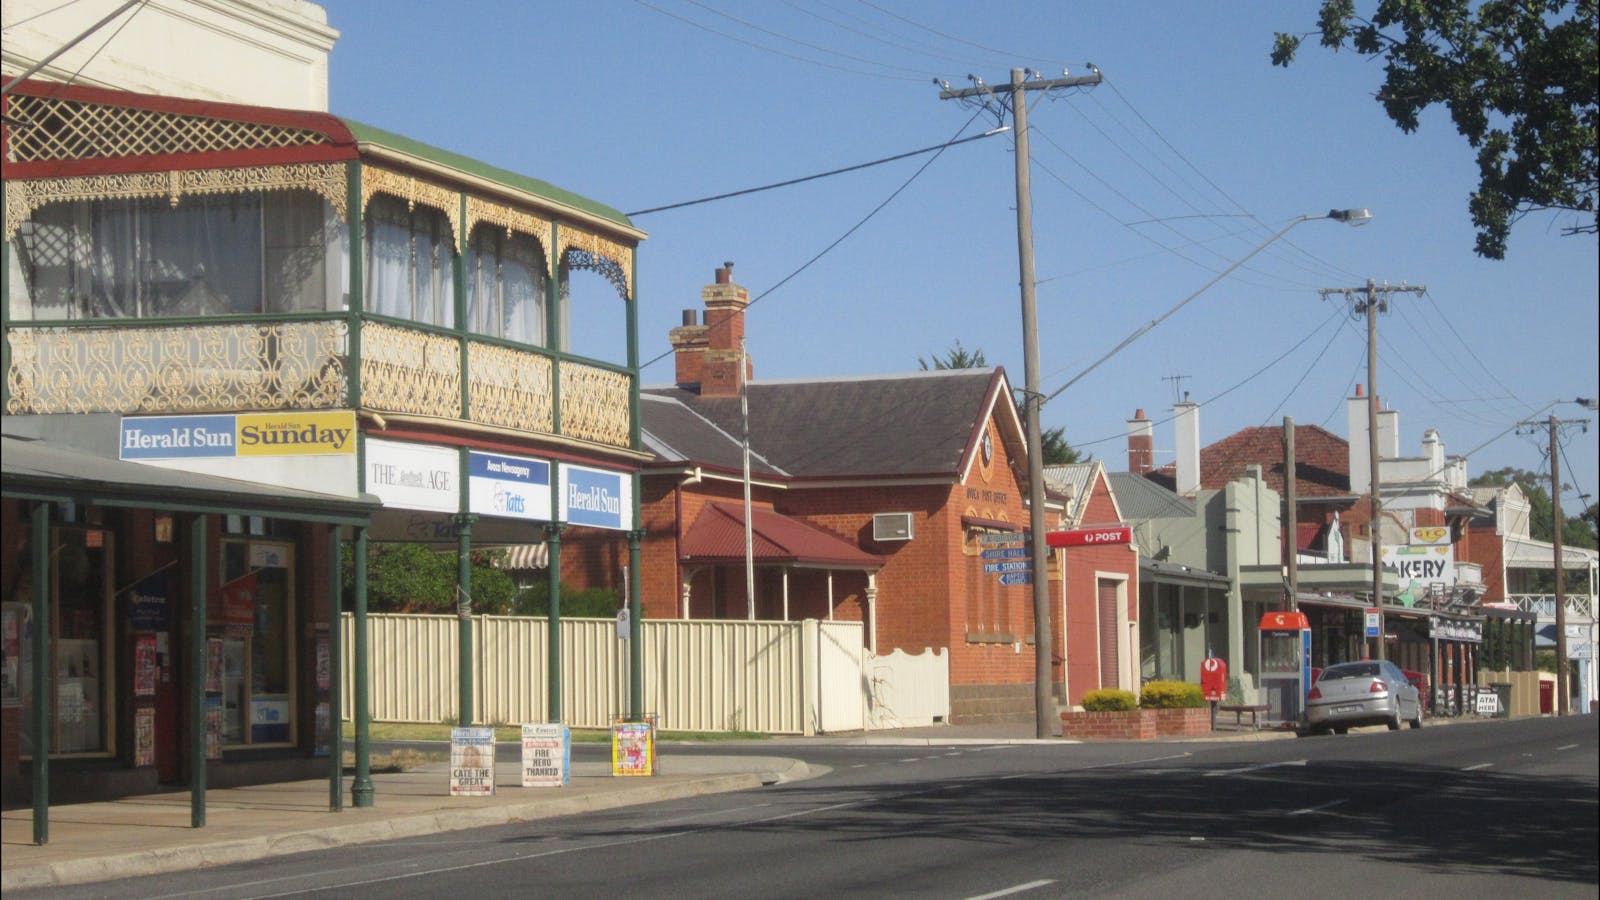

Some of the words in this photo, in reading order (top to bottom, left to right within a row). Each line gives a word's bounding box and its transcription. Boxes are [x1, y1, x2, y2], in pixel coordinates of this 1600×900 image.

[265, 422, 287, 430] Herald
[288, 422, 301, 430] Sun
[124, 428, 191, 449] Herald
[193, 427, 233, 448] Sun
[241, 424, 352, 449] Sunday
[371, 463, 396, 486] THE
[427, 470, 451, 491] AGE
[505, 491, 525, 513] Tatts
[568, 482, 600, 512] Herald
[601, 491, 619, 514] Sun
[1095, 532, 1122, 541] POST
[1007, 549, 1026, 558] HALL
[984, 562, 999, 573] FIRE
[1002, 561, 1026, 571] STATION
[1382, 559, 1446, 579] KERY
[535, 749, 550, 757] FIRE
[533, 758, 551, 767] HERO
[453, 769, 474, 778] CATE
[474, 769, 489, 778] THE
[525, 767, 559, 776] THANKED
[458, 777, 484, 786] GREAT
